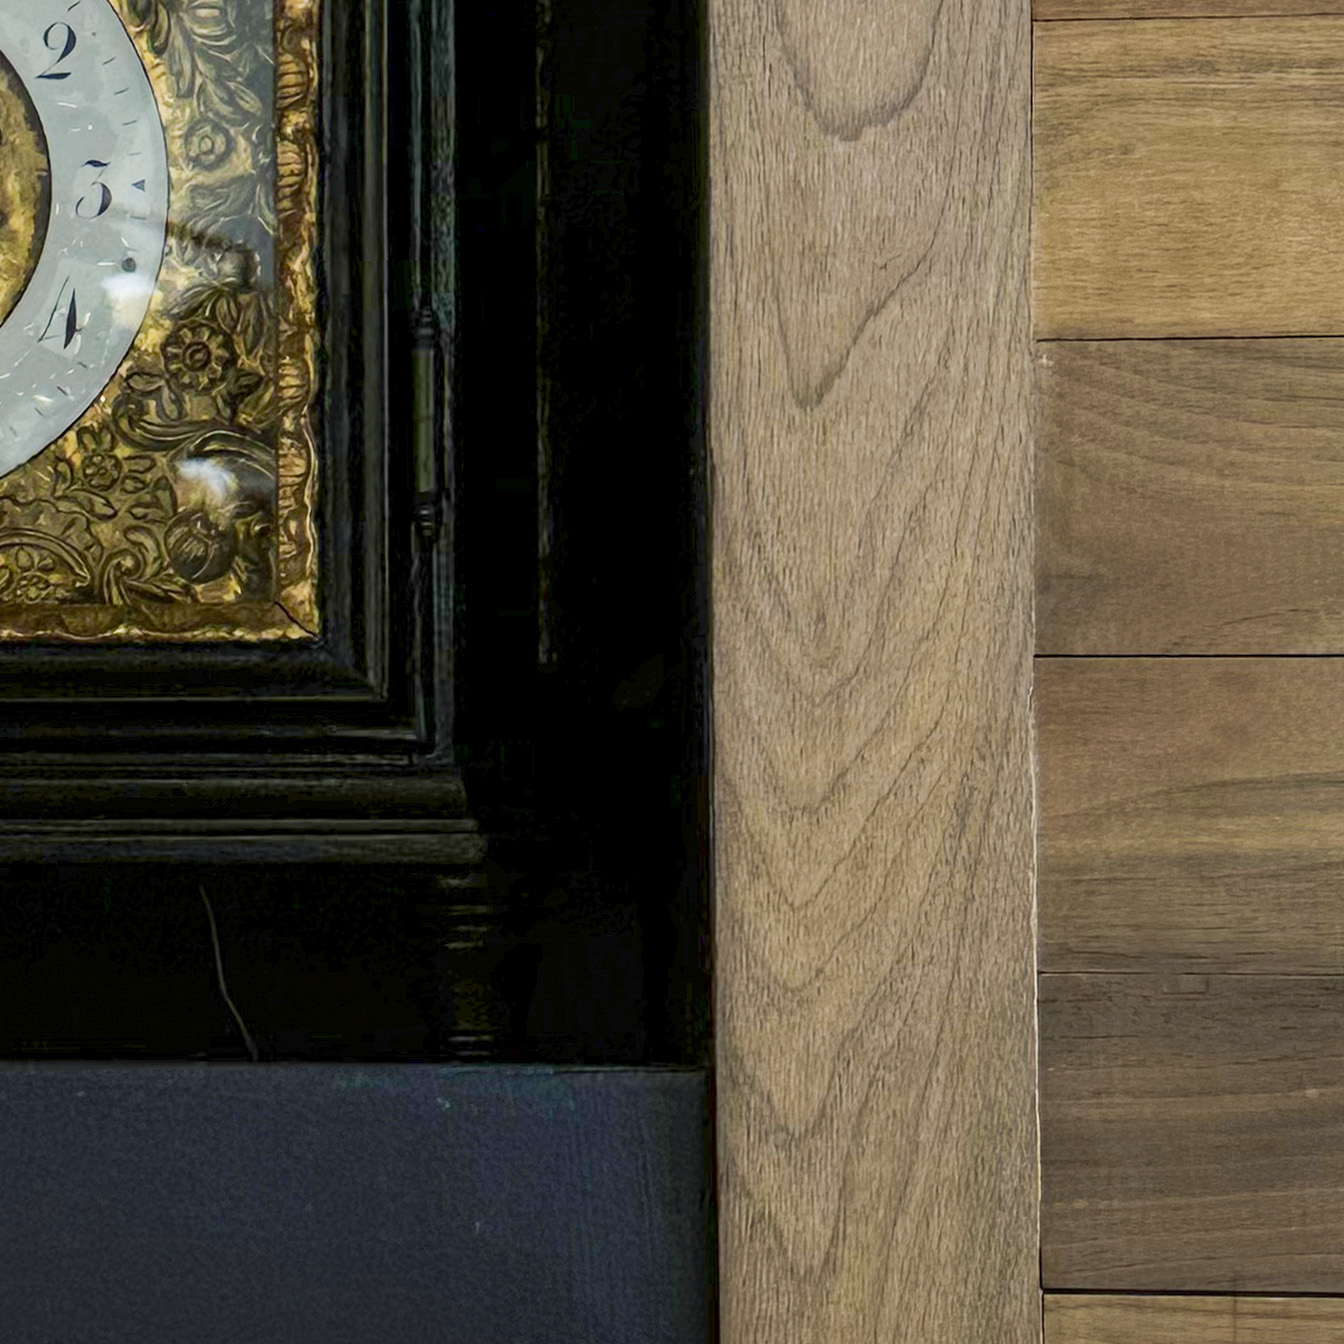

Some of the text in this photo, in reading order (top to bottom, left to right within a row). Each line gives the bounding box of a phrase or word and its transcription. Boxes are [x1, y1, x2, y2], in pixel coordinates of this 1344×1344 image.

[36, 22, 77, 80] 2
[76, 159, 113, 218] 3
[38, 275, 78, 350] 4
